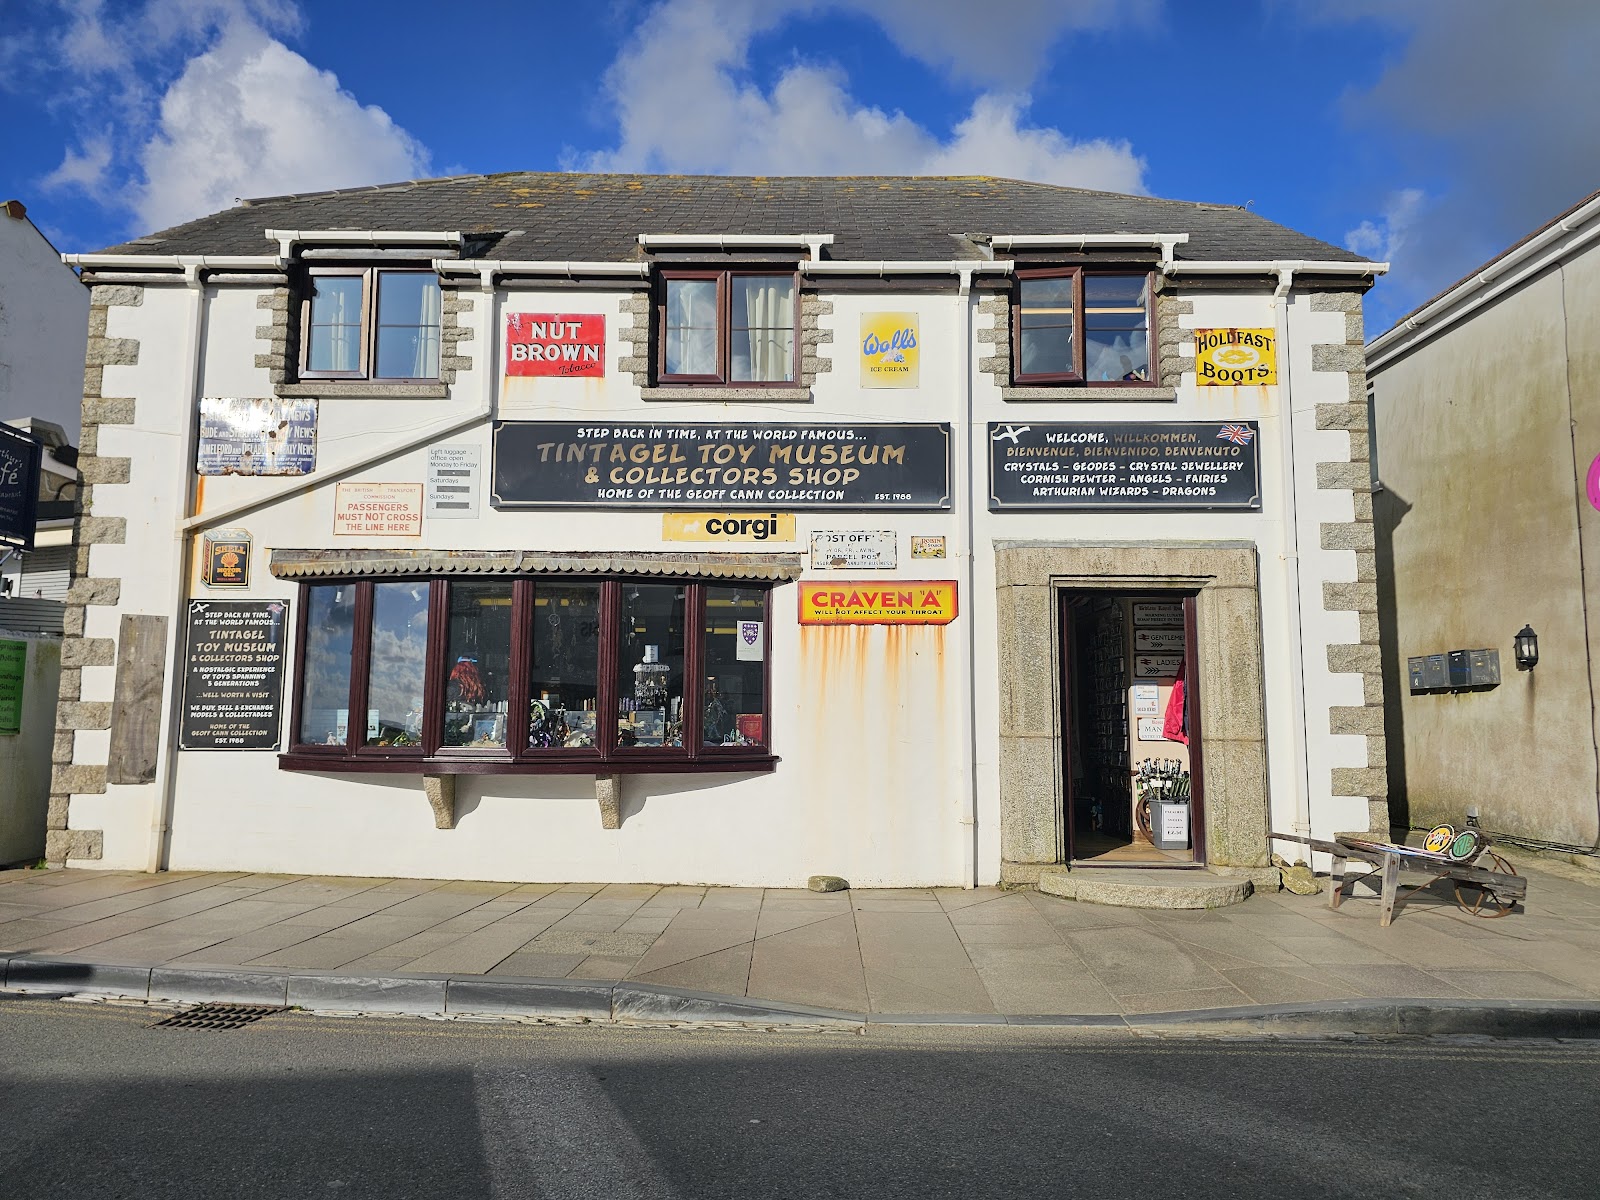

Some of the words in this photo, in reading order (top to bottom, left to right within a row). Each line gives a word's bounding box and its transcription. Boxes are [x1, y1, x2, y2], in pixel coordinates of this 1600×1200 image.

[531, 321, 582, 340] NUT
[511, 343, 600, 362] BROWN
[559, 362, 596, 375] Tobacco
[289, 410, 311, 421] NEWS
[294, 426, 315, 438] NEWS
[577, 428, 610, 439] STEP
[613, 428, 644, 439] BACK
[648, 428, 662, 439] IN
[667, 429, 701, 440] TIME,
[705, 430, 721, 439] AT
[725, 430, 748, 439] THE
[753, 430, 797, 440] WORLD
[801, 430, 867, 440] FAMOUS...
[1046, 433, 1109, 443] WELCOME,
[1114, 433, 1201, 444] WILLKOMMEN,
[200, 443, 233, 455] AMELFORD
[297, 443, 315, 455] NEWS
[536, 442, 687, 463] TINTAGEL
[697, 444, 756, 464] TOY
[768, 444, 906, 465] MUSEUM
[1006, 447, 1079, 457] BIENVENUE,
[1084, 447, 1160, 457] BIENVENIDO,
[1164, 446, 1241, 457] BENVENUTO
[0, 449, 23, 469] rthur's
[1004, 462, 1059, 471] CRYSTALS
[1072, 462, 1116, 471] GEODES
[1129, 462, 1178, 471] CRYSTAL
[1181, 462, 1244, 471] JEWELLERY
[0, 461, 19, 486] fé
[584, 467, 600, 484] &
[609, 467, 778, 485] COLLECTORS
[788, 467, 860, 486] SHOP
[1020, 474, 1069, 484] CORNISH
[1072, 474, 1116, 484] PEWTER
[1129, 474, 1172, 483] ANGELS
[1185, 474, 1228, 483] FAIRIES
[597, 488, 634, 499] HOME
[637, 489, 654, 499] OF
[658, 489, 682, 499] THE
[686, 489, 725, 499] GEOFF
[729, 490, 764, 500] CANN
[768, 490, 845, 500] COLLECTION
[1032, 487, 1095, 496] ARTHURIAN
[1099, 487, 1149, 496] WIZARDS
[1162, 487, 1216, 496] DRAGONS
[347, 503, 409, 511] PASSENGERS
[337, 513, 363, 521] MUST
[365, 513, 385, 521] NOT
[386, 513, 419, 521] CROSS
[346, 523, 363, 531] THE
[365, 523, 385, 531] LINE
[387, 523, 410, 531] HERE
[705, 513, 777, 540] corgi
[818, 534, 846, 543] OST
[849, 534, 873, 543] OFF
[214, 545, 246, 555] SHELL
[811, 590, 913, 608] CRAVEN
[209, 630, 265, 640] TINTAGEL
[196, 643, 220, 652] TOY
[223, 643, 276, 652] MUSEUM
